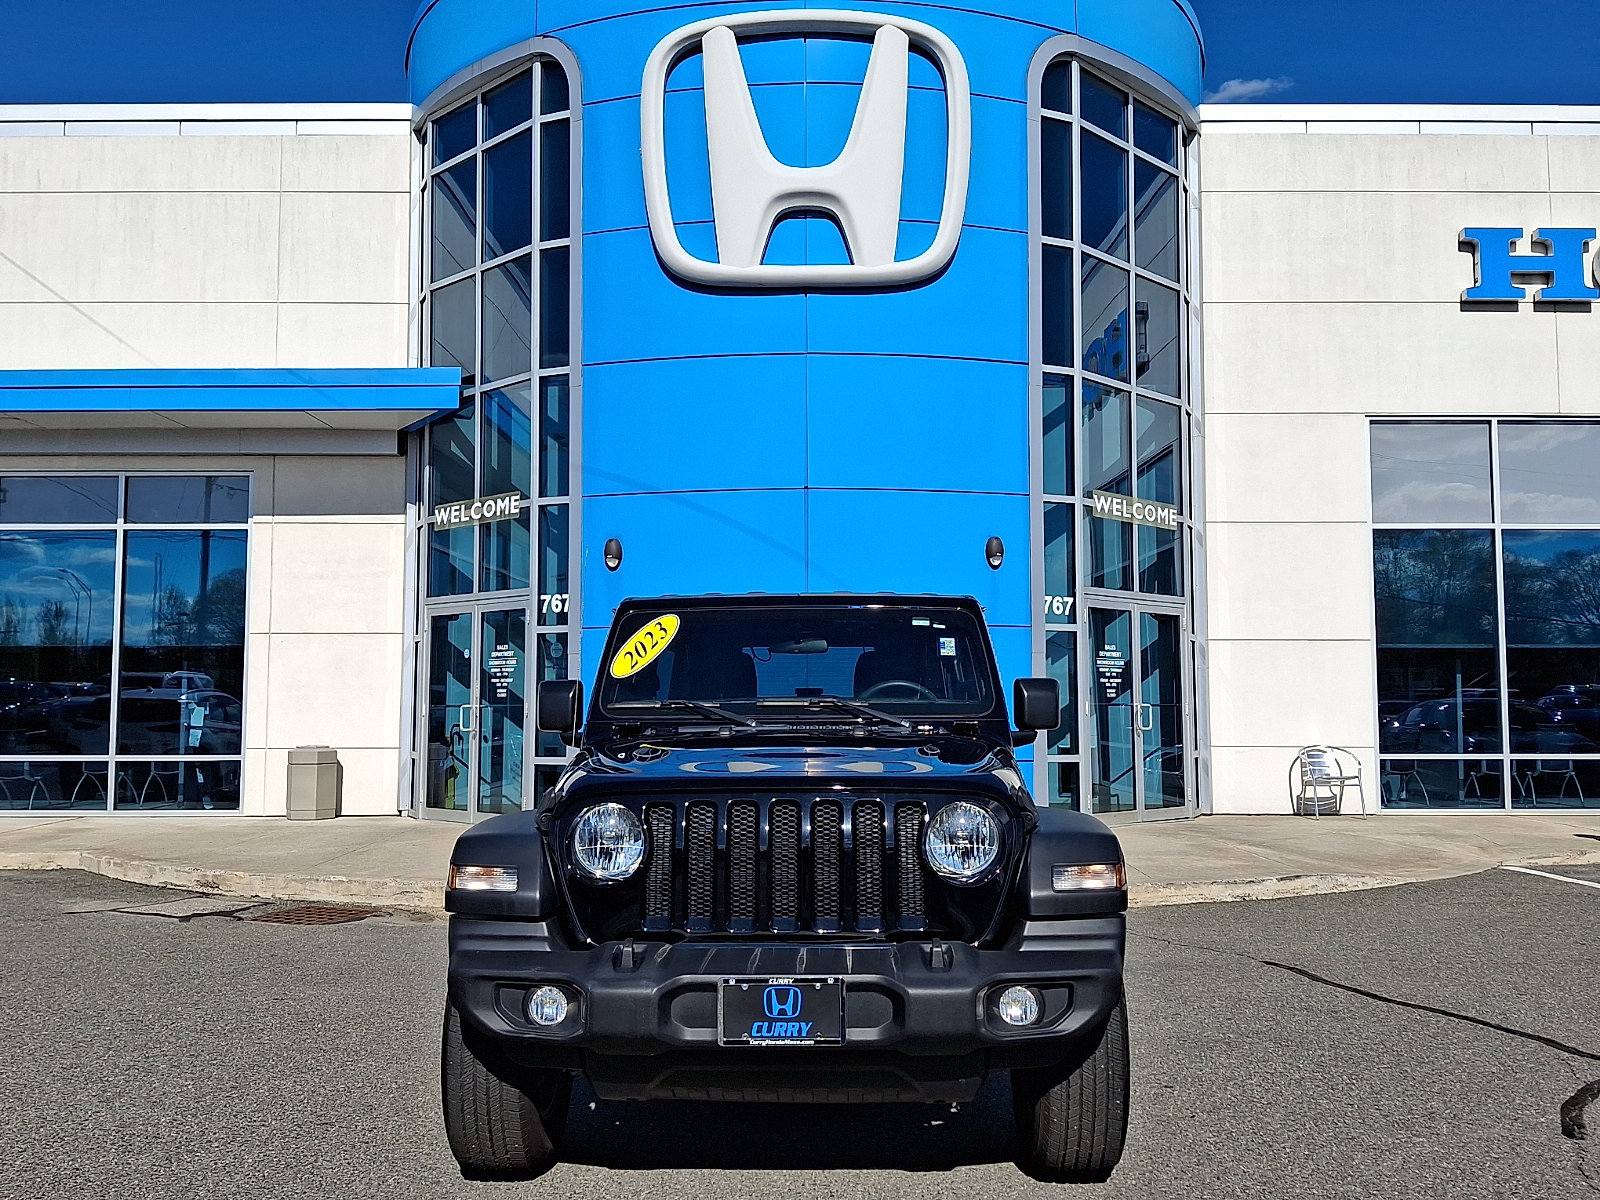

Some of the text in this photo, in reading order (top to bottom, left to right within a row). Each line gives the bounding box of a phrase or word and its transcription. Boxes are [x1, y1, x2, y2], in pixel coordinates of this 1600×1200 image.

[1459, 227, 1600, 302] H
[435, 495, 520, 526] WELCOME
[1093, 494, 1178, 526] WELCOME
[540, 594, 570, 614] 767
[1044, 595, 1074, 616] 767
[624, 621, 668, 670] 2023
[751, 1021, 813, 1037] CURRY
